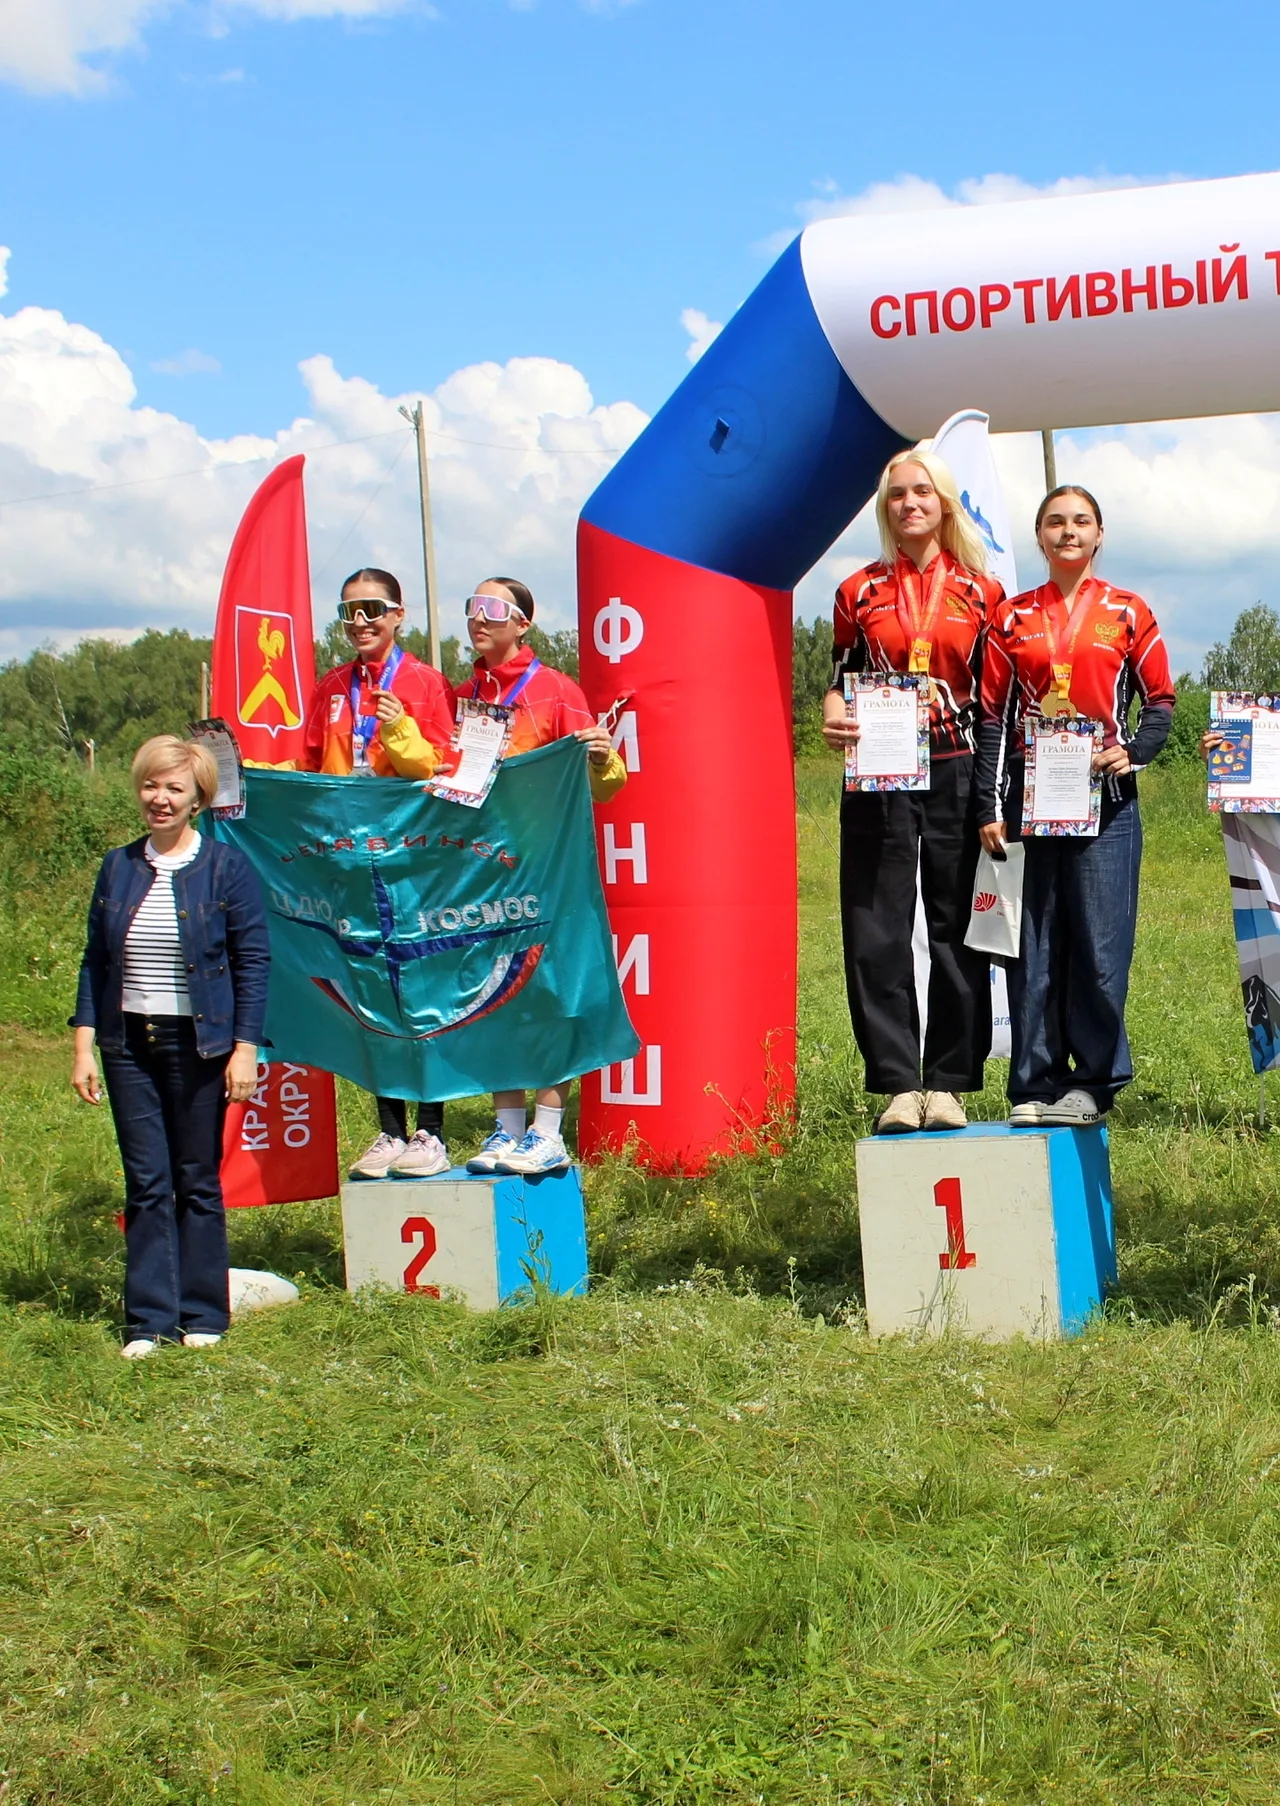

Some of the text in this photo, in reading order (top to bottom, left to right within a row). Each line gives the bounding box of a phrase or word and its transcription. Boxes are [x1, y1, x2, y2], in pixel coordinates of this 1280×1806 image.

[869, 242, 1250, 339] СПОРТИВНЫЙ
[863, 700, 911, 709] ГРАМОТА
[466, 725, 499, 738] ГРАМОТА
[1042, 745, 1086, 754] ГРАМОТА
[418, 894, 542, 933] КОСМОС
[933, 1177, 977, 1270] 1
[401, 1217, 440, 1300] 2
